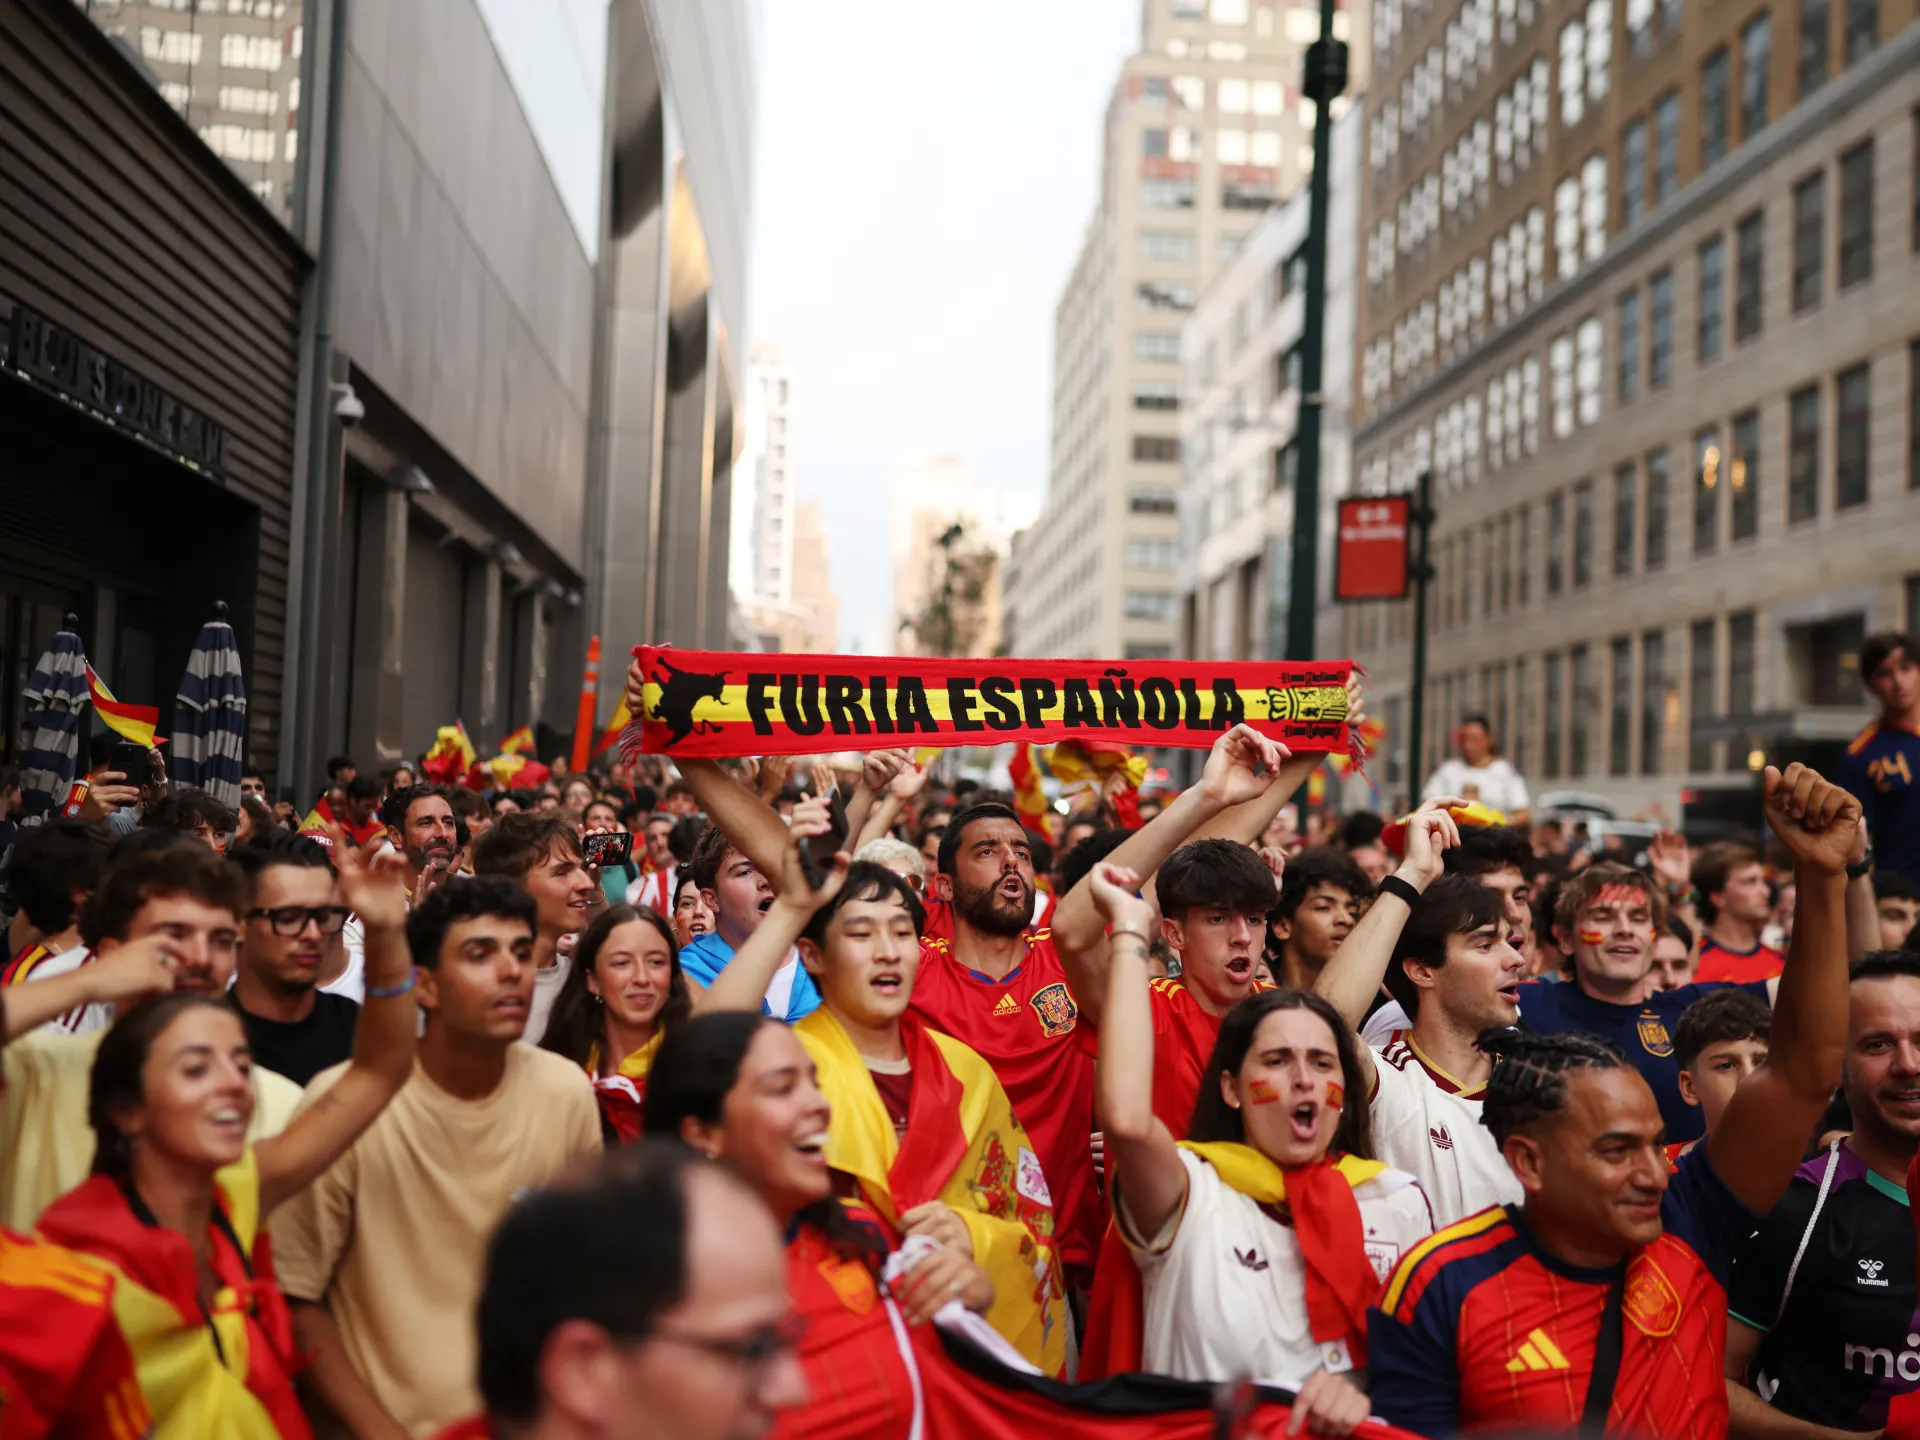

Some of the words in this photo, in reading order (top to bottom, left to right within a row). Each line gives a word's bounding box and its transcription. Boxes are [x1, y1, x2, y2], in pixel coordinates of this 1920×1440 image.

[745, 673, 938, 736] FURIA
[946, 667, 1246, 733] ESPAÑOLA
[1867, 751, 1913, 793] 24
[992, 1004, 1022, 1017] adidas
[1857, 1276, 1889, 1287] hummel
